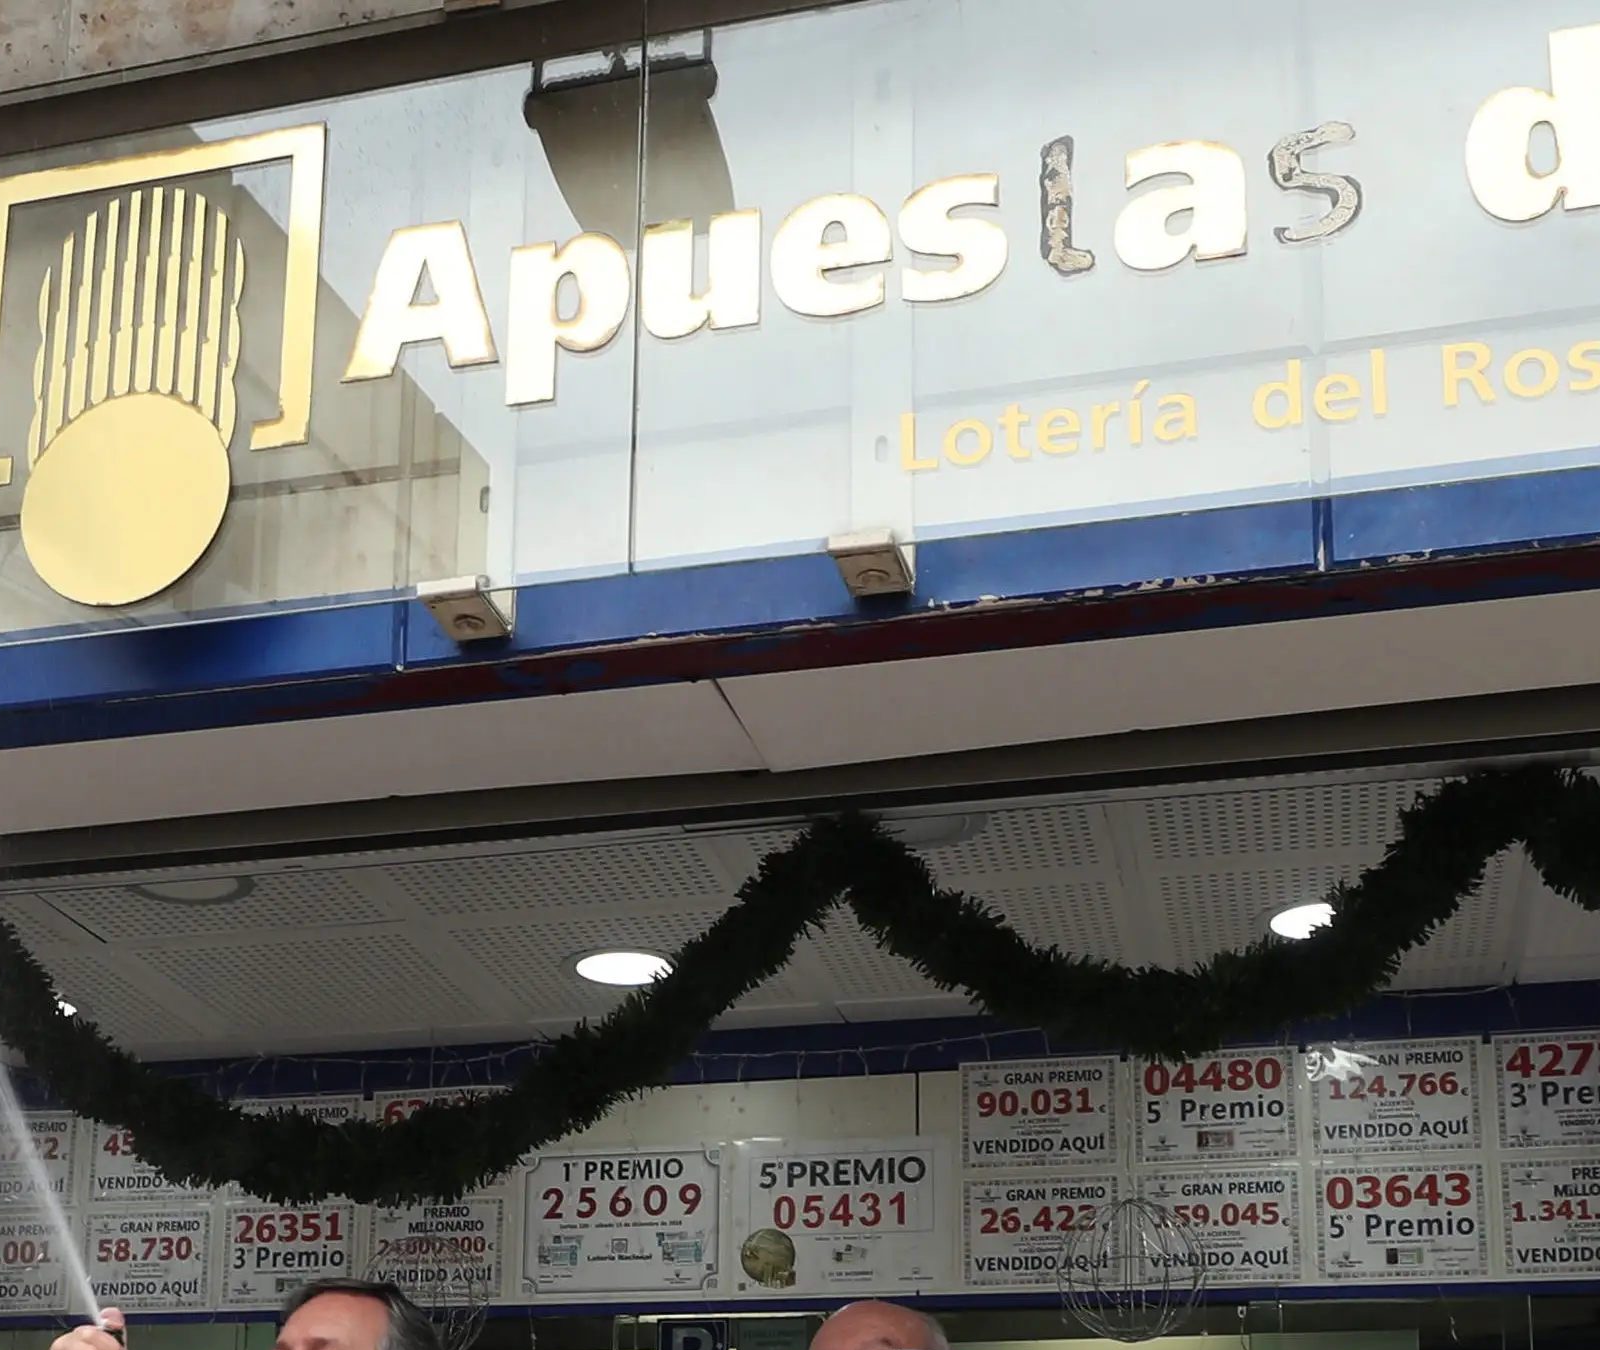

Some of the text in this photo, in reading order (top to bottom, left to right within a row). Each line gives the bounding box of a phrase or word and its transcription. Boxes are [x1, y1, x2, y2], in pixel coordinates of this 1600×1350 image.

[901, 380, 1200, 472] Lotería
[1253, 347, 1388, 431] del
[1405, 1050, 1464, 1066] PREMIO
[1004, 1068, 1103, 1085] GRAN PREMIO
[1143, 1057, 1283, 1096] 04480
[1180, 1094, 1285, 1122] Premio
[1324, 1116, 1469, 1140] VENDIDO AQUÍ
[972, 1132, 1106, 1155] VENDIDO AQUÍ
[584, 1157, 684, 1182] PREMIO
[787, 1155, 927, 1189] PREMIO
[98, 1176, 163, 1190] VENDIDO
[1006, 1185, 1106, 1201] GRAN PREMIO
[1181, 1180, 1285, 1196] GRAN PREMIO
[1326, 1173, 1472, 1210] 03643
[423, 1206, 470, 1218] PREMIO
[542, 1183, 703, 1220] 25609
[773, 1190, 906, 1229] 05431
[120, 1220, 200, 1233] GRAN PREMIO
[234, 1212, 344, 1245] 26351
[408, 1219, 485, 1234] MILLONARIO
[1365, 1210, 1476, 1238] Premio
[256, 1244, 345, 1269] Premio
[974, 1255, 1057, 1272] VENDIDO
[1150, 1246, 1290, 1268] VENDIDO AQUÍ
[23, 1280, 58, 1297] AQUÍ
[92, 1278, 198, 1296] VENDIDO AQUÍ
